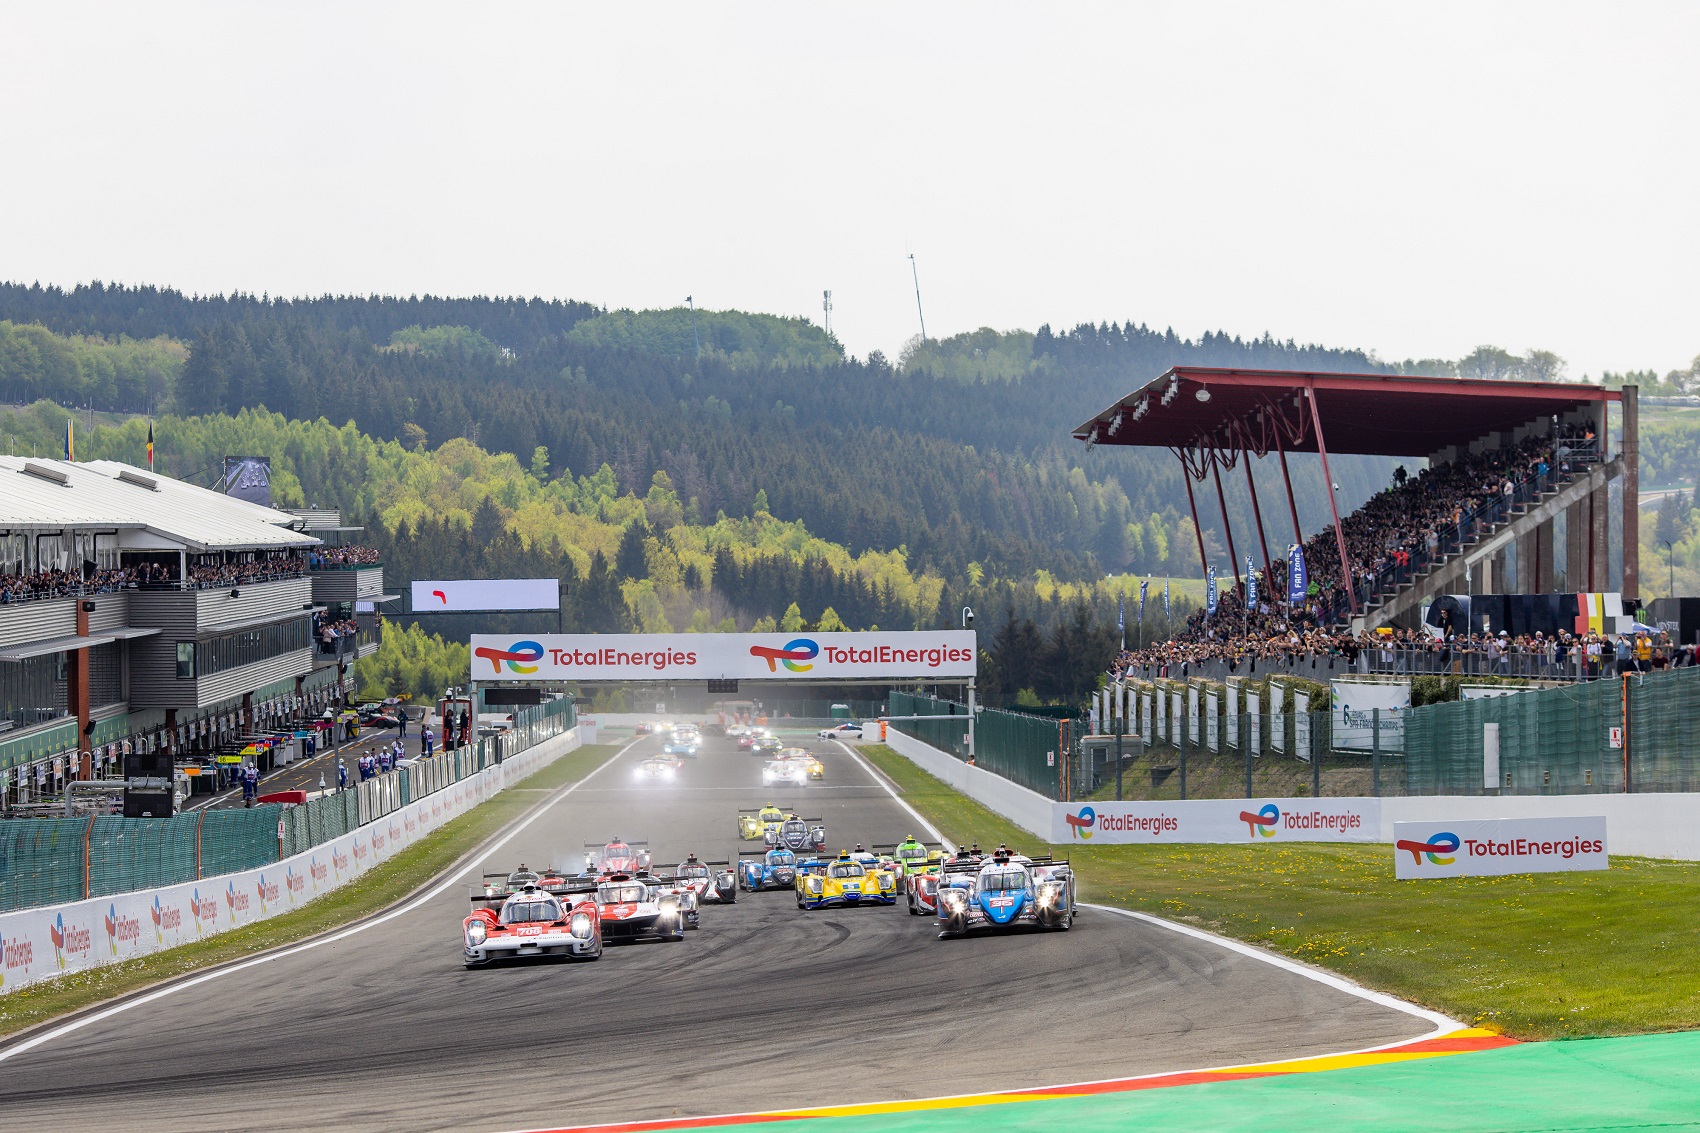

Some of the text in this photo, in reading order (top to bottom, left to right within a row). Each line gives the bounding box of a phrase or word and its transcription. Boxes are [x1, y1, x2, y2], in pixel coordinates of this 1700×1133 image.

[1248, 561, 1256, 581] ZONE
[1294, 552, 1302, 571] ZONE
[1294, 573, 1302, 588] FAN
[549, 647, 697, 670] TotalEnergies
[824, 644, 972, 667] TotalEnergies
[1097, 812, 1178, 836] TotalEnergies
[1282, 810, 1361, 833] TotalEnergies
[1464, 836, 1603, 859] TotalEnergies
[64, 922, 91, 958] TotalEnergies
[518, 927, 542, 937] 708
[3, 933, 33, 974] TotalEnergies
